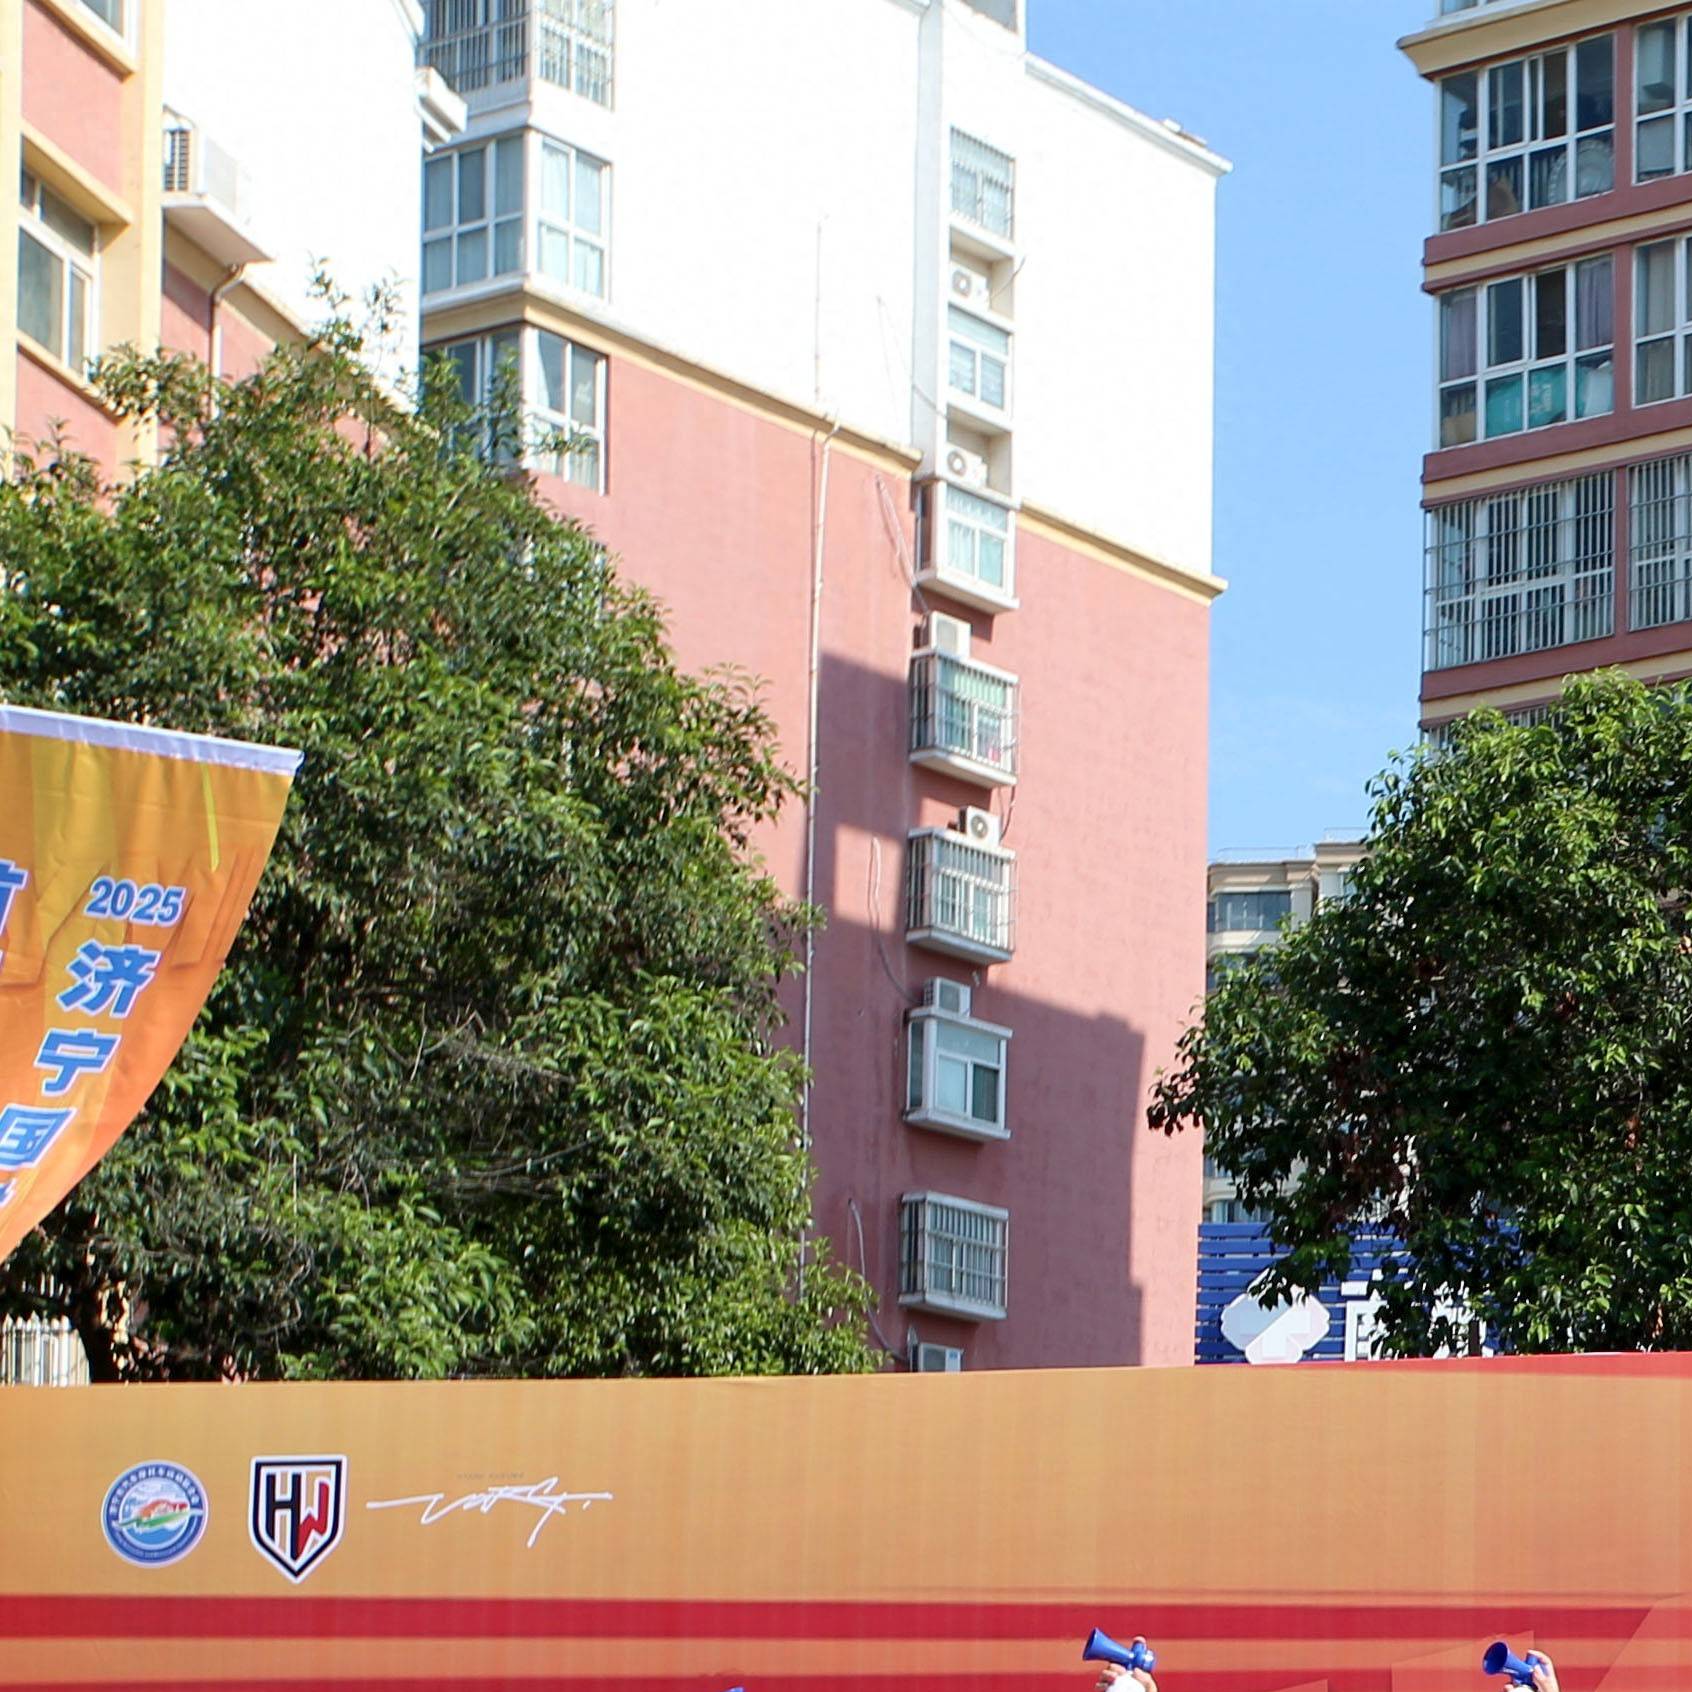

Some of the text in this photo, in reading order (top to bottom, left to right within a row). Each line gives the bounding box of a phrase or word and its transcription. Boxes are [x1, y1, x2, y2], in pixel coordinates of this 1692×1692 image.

[84, 875, 187, 930] 2025
[0, 938, 163, 1208] 济宁国
